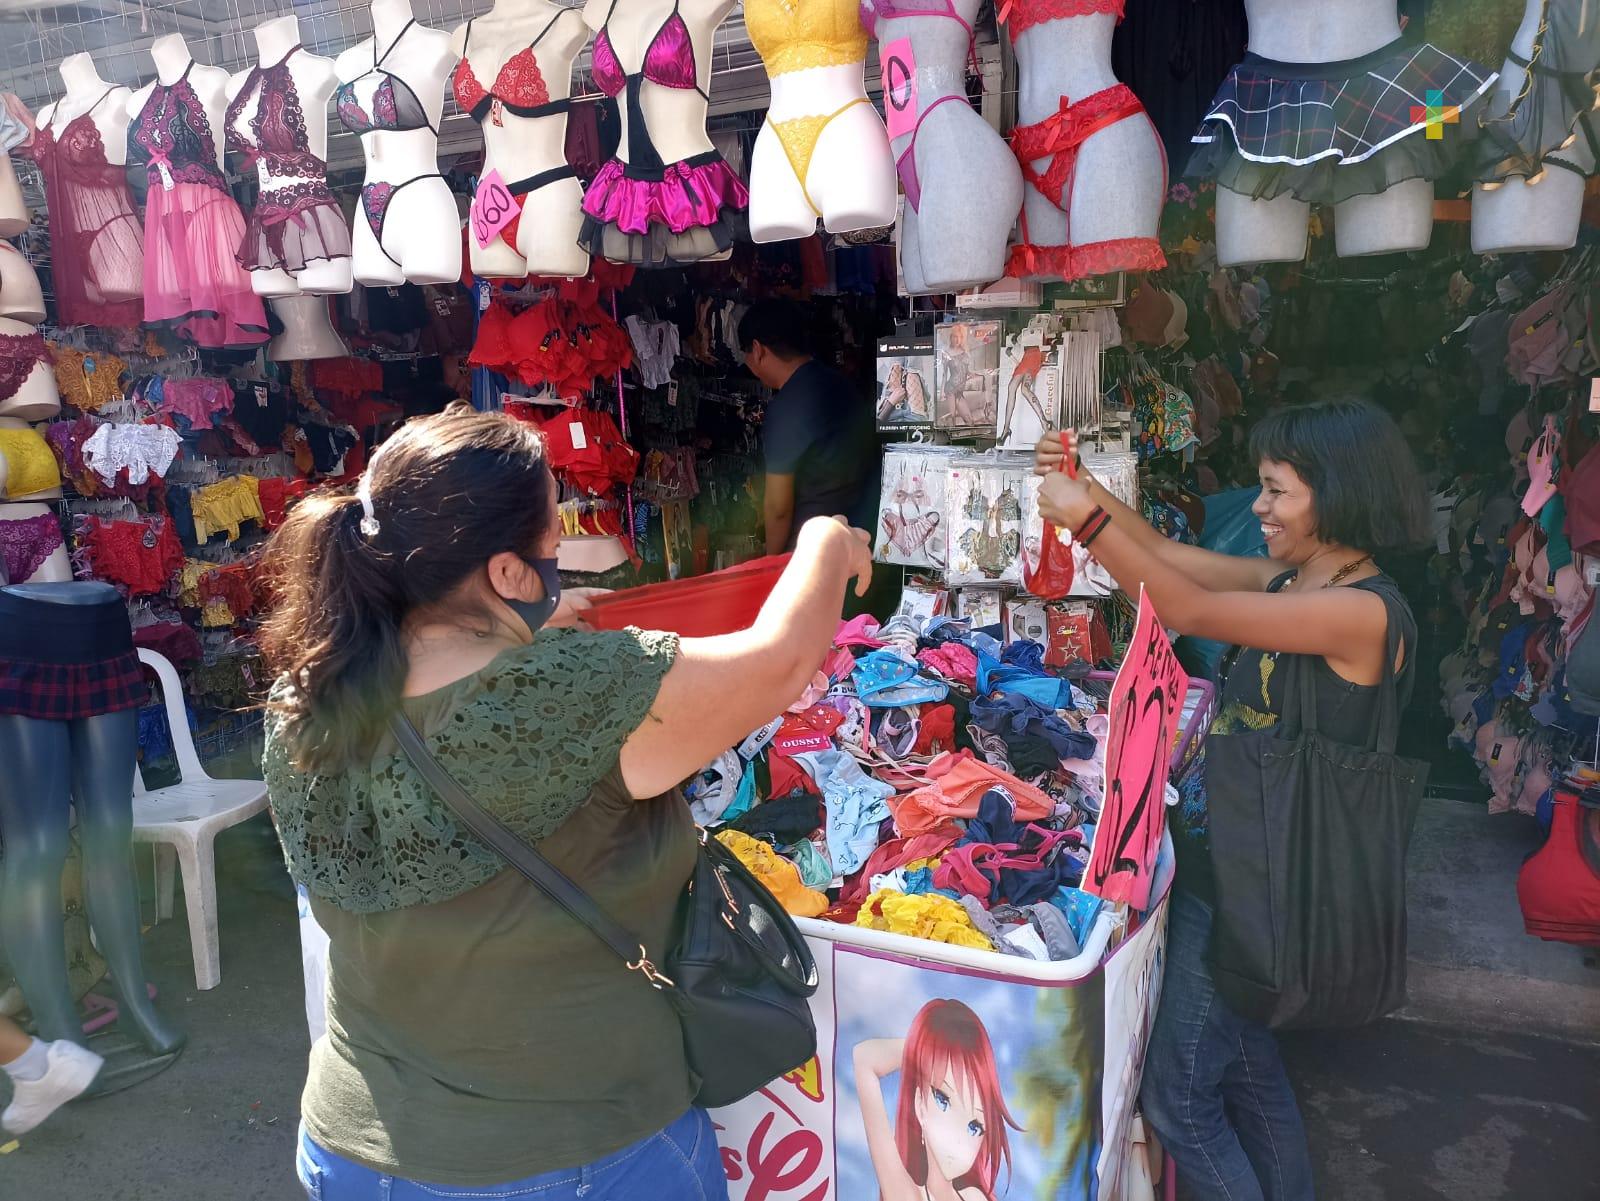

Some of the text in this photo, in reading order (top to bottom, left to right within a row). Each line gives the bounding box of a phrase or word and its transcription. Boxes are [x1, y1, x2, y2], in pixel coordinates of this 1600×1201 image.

[475, 183, 510, 244] $60
[1045, 373, 1055, 416] Graceful
[782, 736, 822, 749] OUSNY
